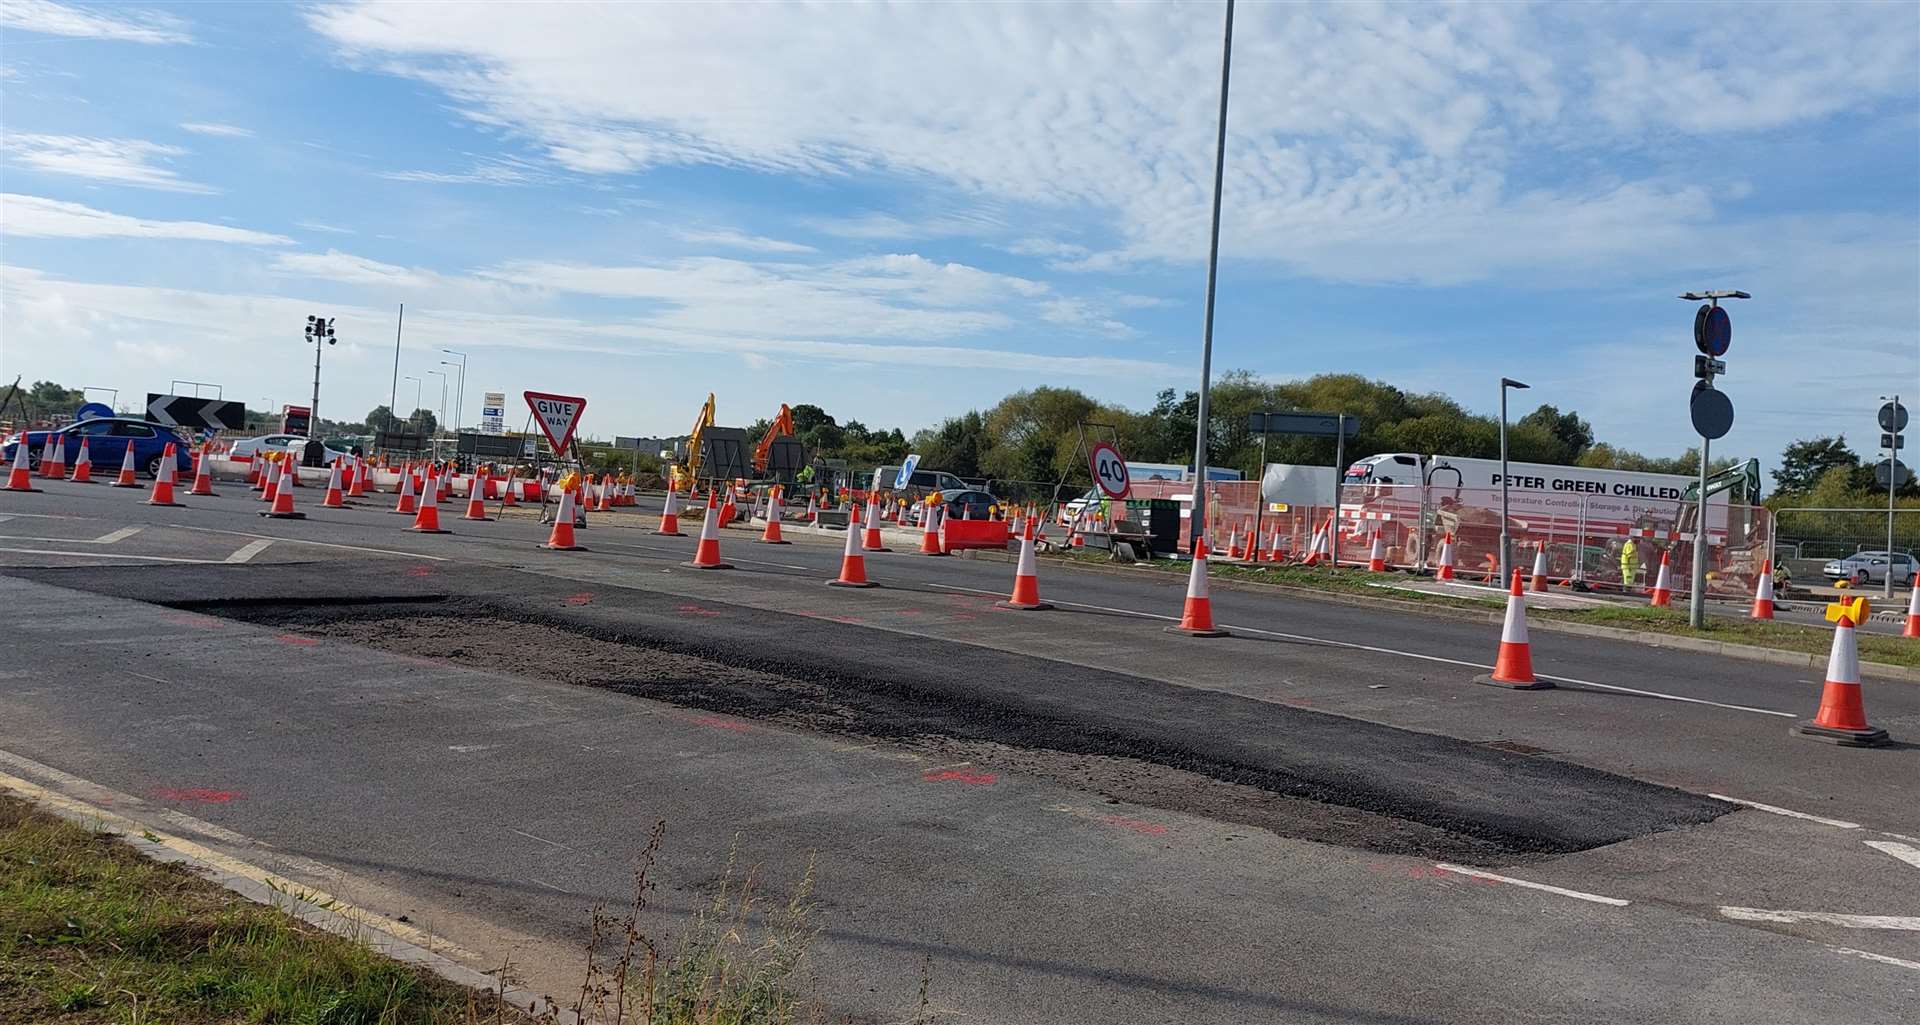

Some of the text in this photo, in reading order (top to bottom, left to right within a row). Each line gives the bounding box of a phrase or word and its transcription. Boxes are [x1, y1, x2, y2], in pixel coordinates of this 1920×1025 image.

[538, 400, 572, 416] GIVE
[546, 416, 568, 428] WAY
[1099, 459, 1125, 483] 40
[1491, 473, 1545, 489] PETER
[1552, 478, 1606, 494] GREEN
[1613, 483, 1680, 500] CHILLED
[1491, 494, 1543, 505] Teperature
[1545, 498, 1585, 509] Controlle
[1590, 502, 1621, 513] Storage
